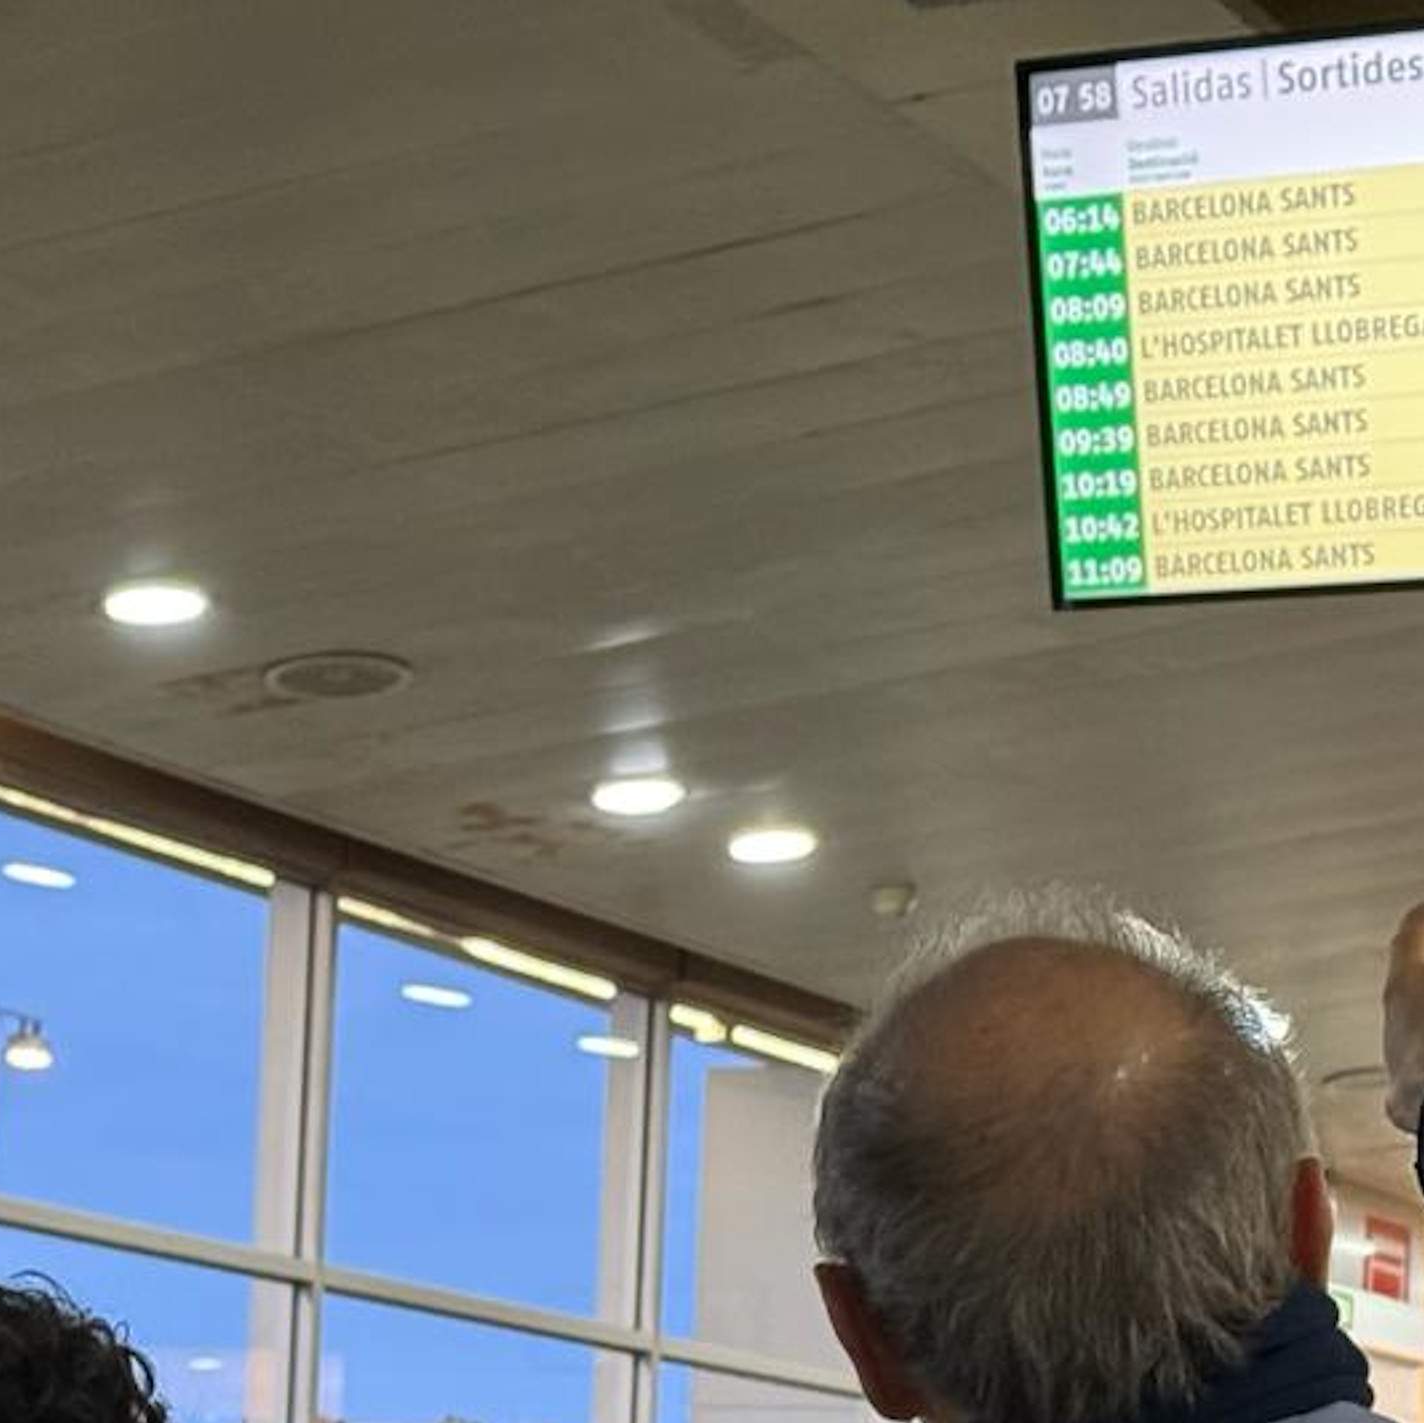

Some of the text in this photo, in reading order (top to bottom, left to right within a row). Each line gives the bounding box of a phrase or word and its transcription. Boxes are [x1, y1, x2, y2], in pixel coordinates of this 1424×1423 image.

[1133, 70, 1251, 109] Salidas
[1278, 52, 1422, 96] Sortides
[1044, 203, 1119, 235] 06:14
[1133, 189, 1272, 225] BARCELONA
[1280, 182, 1355, 212] SANTS
[1047, 250, 1122, 280] 07:44
[1135, 235, 1275, 270] BARCELONA
[1283, 229, 1358, 257] SANTS
[1050, 297, 1126, 324] 08:09
[1138, 281, 1278, 315] BARCELONA
[1285, 275, 1361, 302] SANTS
[1053, 340, 1129, 369] 08:40
[1141, 325, 1304, 359] L'HOSPITALET
[1056, 384, 1132, 412] 08:49
[1144, 370, 1282, 403] BARCELONA
[1290, 366, 1366, 392] SANTS
[1059, 428, 1134, 456] 09:39
[1147, 415, 1284, 447] BARCELONA
[1292, 410, 1368, 438] SANTS
[1062, 472, 1136, 500] 10:19
[1150, 460, 1287, 491] BARCELONA
[1295, 455, 1371, 483] SANTS
[1064, 517, 1140, 543] 10:42
[1152, 504, 1313, 536] L'HOSPITALET
[1068, 559, 1143, 585] 11:09
[1156, 548, 1292, 578] BARCELONA
[1300, 543, 1375, 570] SANTS
